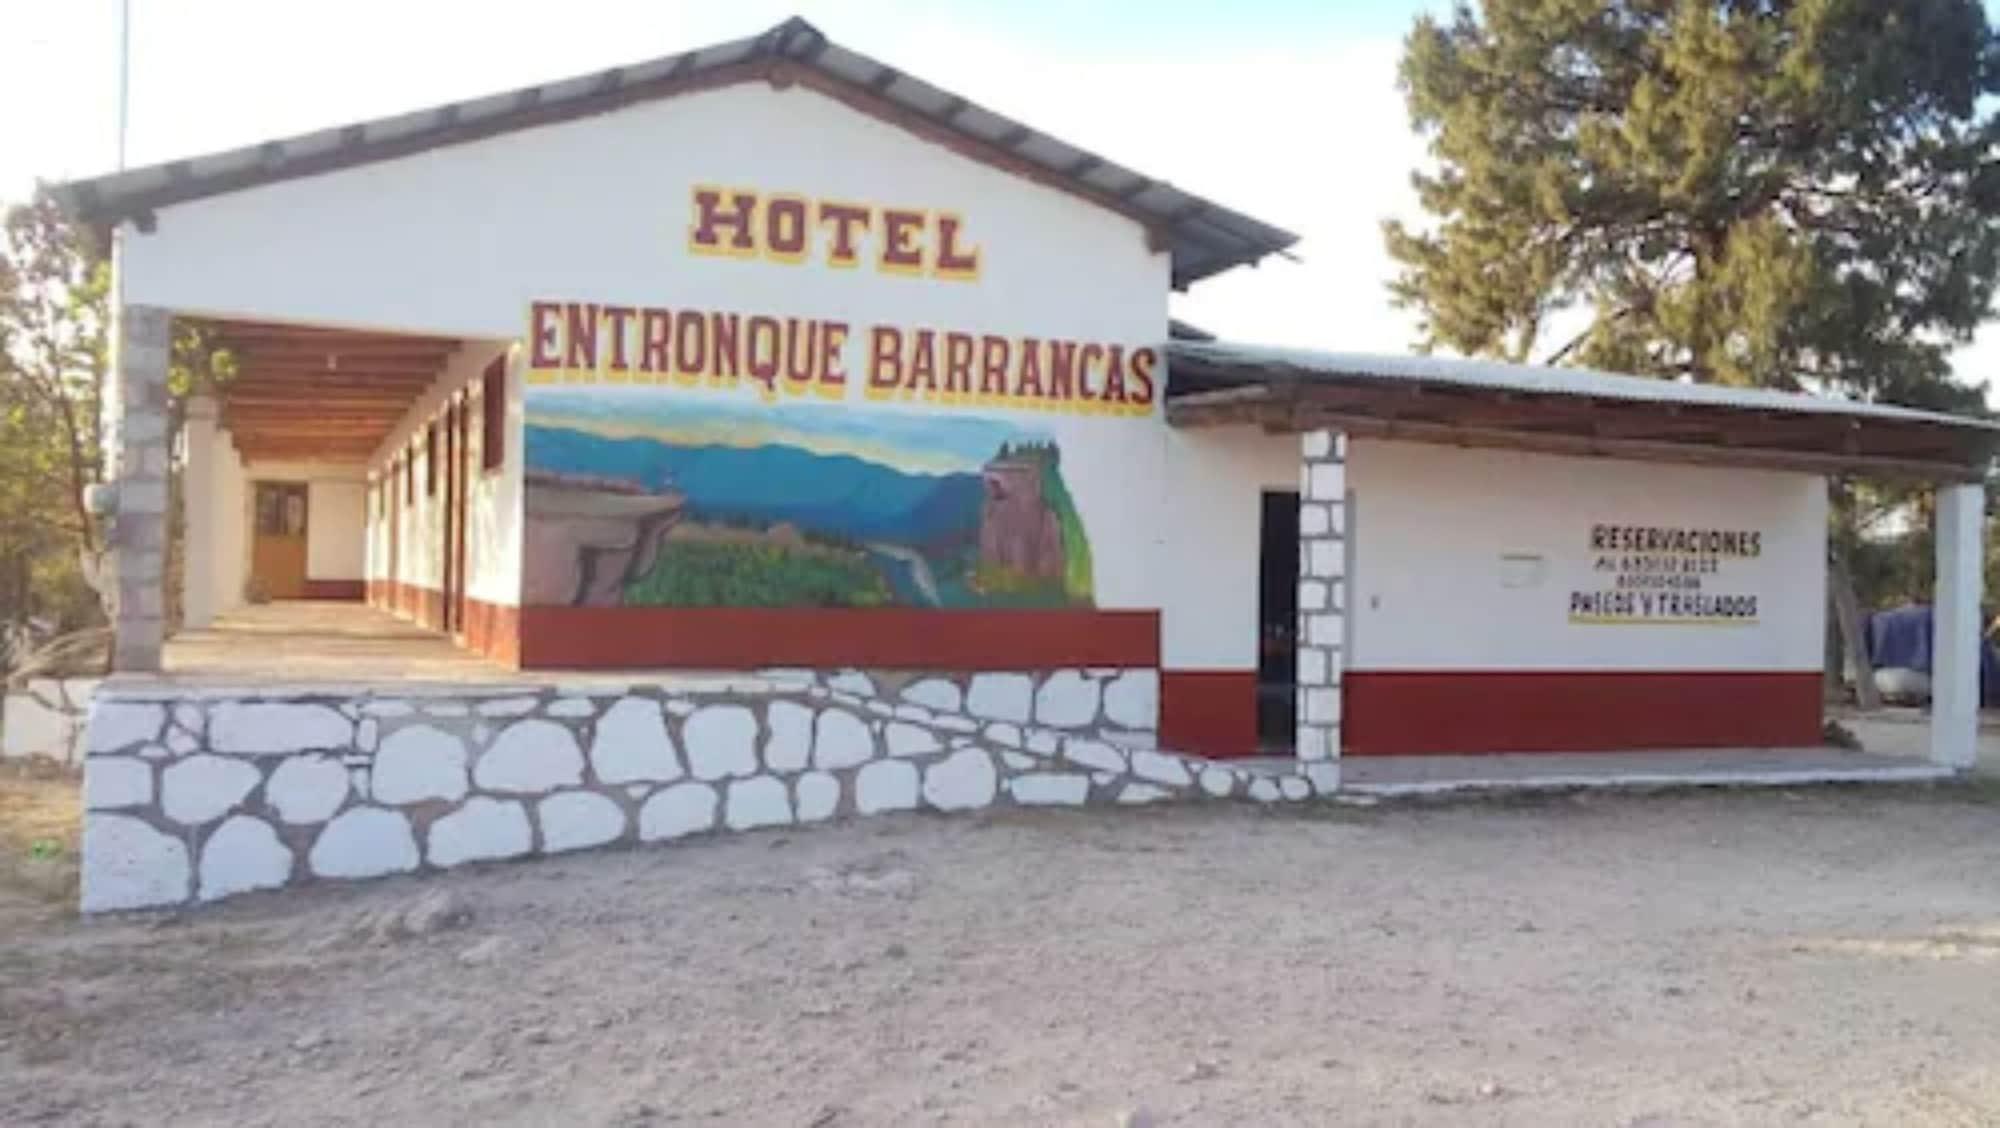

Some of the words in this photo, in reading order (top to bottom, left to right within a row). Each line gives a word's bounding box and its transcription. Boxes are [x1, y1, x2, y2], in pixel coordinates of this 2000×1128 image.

[691, 187, 979, 274] HOTEL
[529, 300, 850, 394] ENTRONQUE
[867, 324, 1158, 406] BARRANCAS
[1590, 524, 1762, 557] RESERVACIONES
[1570, 591, 1635, 616] PASEOS
[1658, 593, 1758, 617] TRASLADOS
